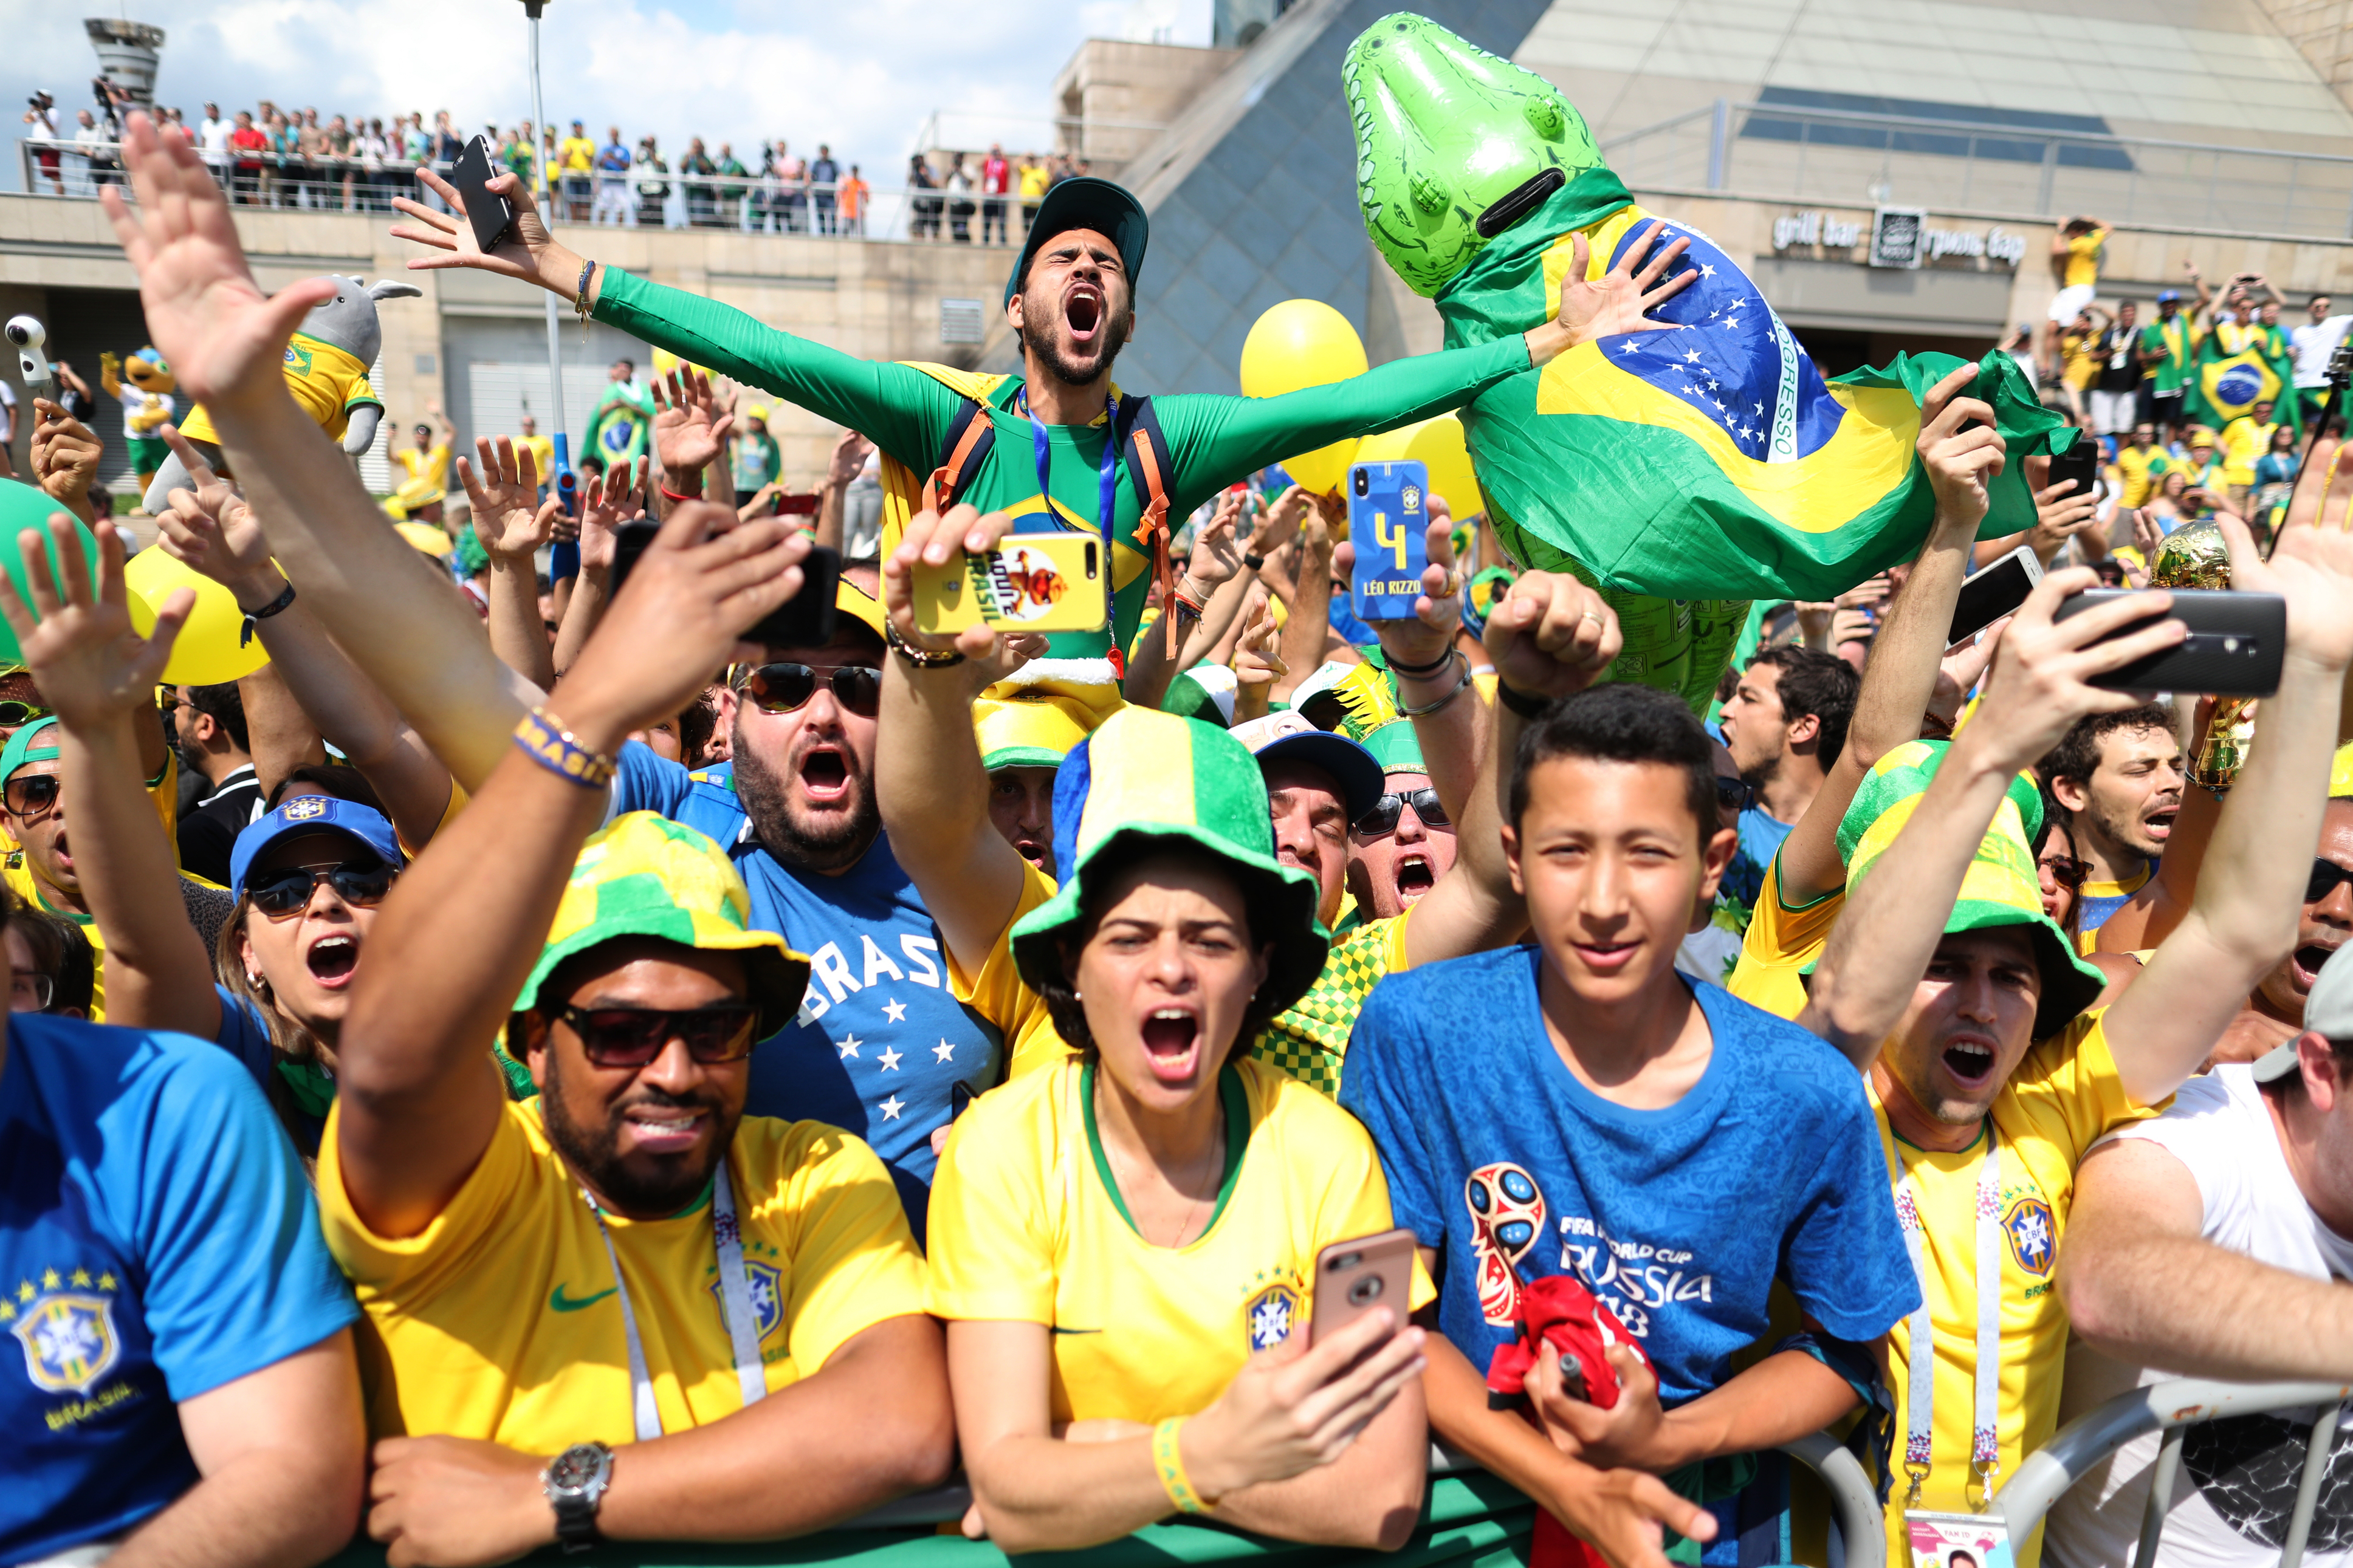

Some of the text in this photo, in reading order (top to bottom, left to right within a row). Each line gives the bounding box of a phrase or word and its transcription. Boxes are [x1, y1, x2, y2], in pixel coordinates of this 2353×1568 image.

[1773, 211, 1861, 250] grill bar
[1924, 229, 1985, 261] гриль
[1987, 225, 2026, 266] бар
[1771, 310, 1795, 455] ROGRESSO
[1375, 512, 1407, 570] 4
[987, 550, 1014, 597] AQUI
[1363, 579, 1421, 596] LÉO RIZZO
[797, 934, 955, 1029] BRAS
[1560, 1216, 1595, 1237] FIFA
[1655, 1248, 1694, 1264] CUP
[2025, 1228, 2041, 1241] CBF
[1560, 1241, 1712, 1309] RUSSIA
